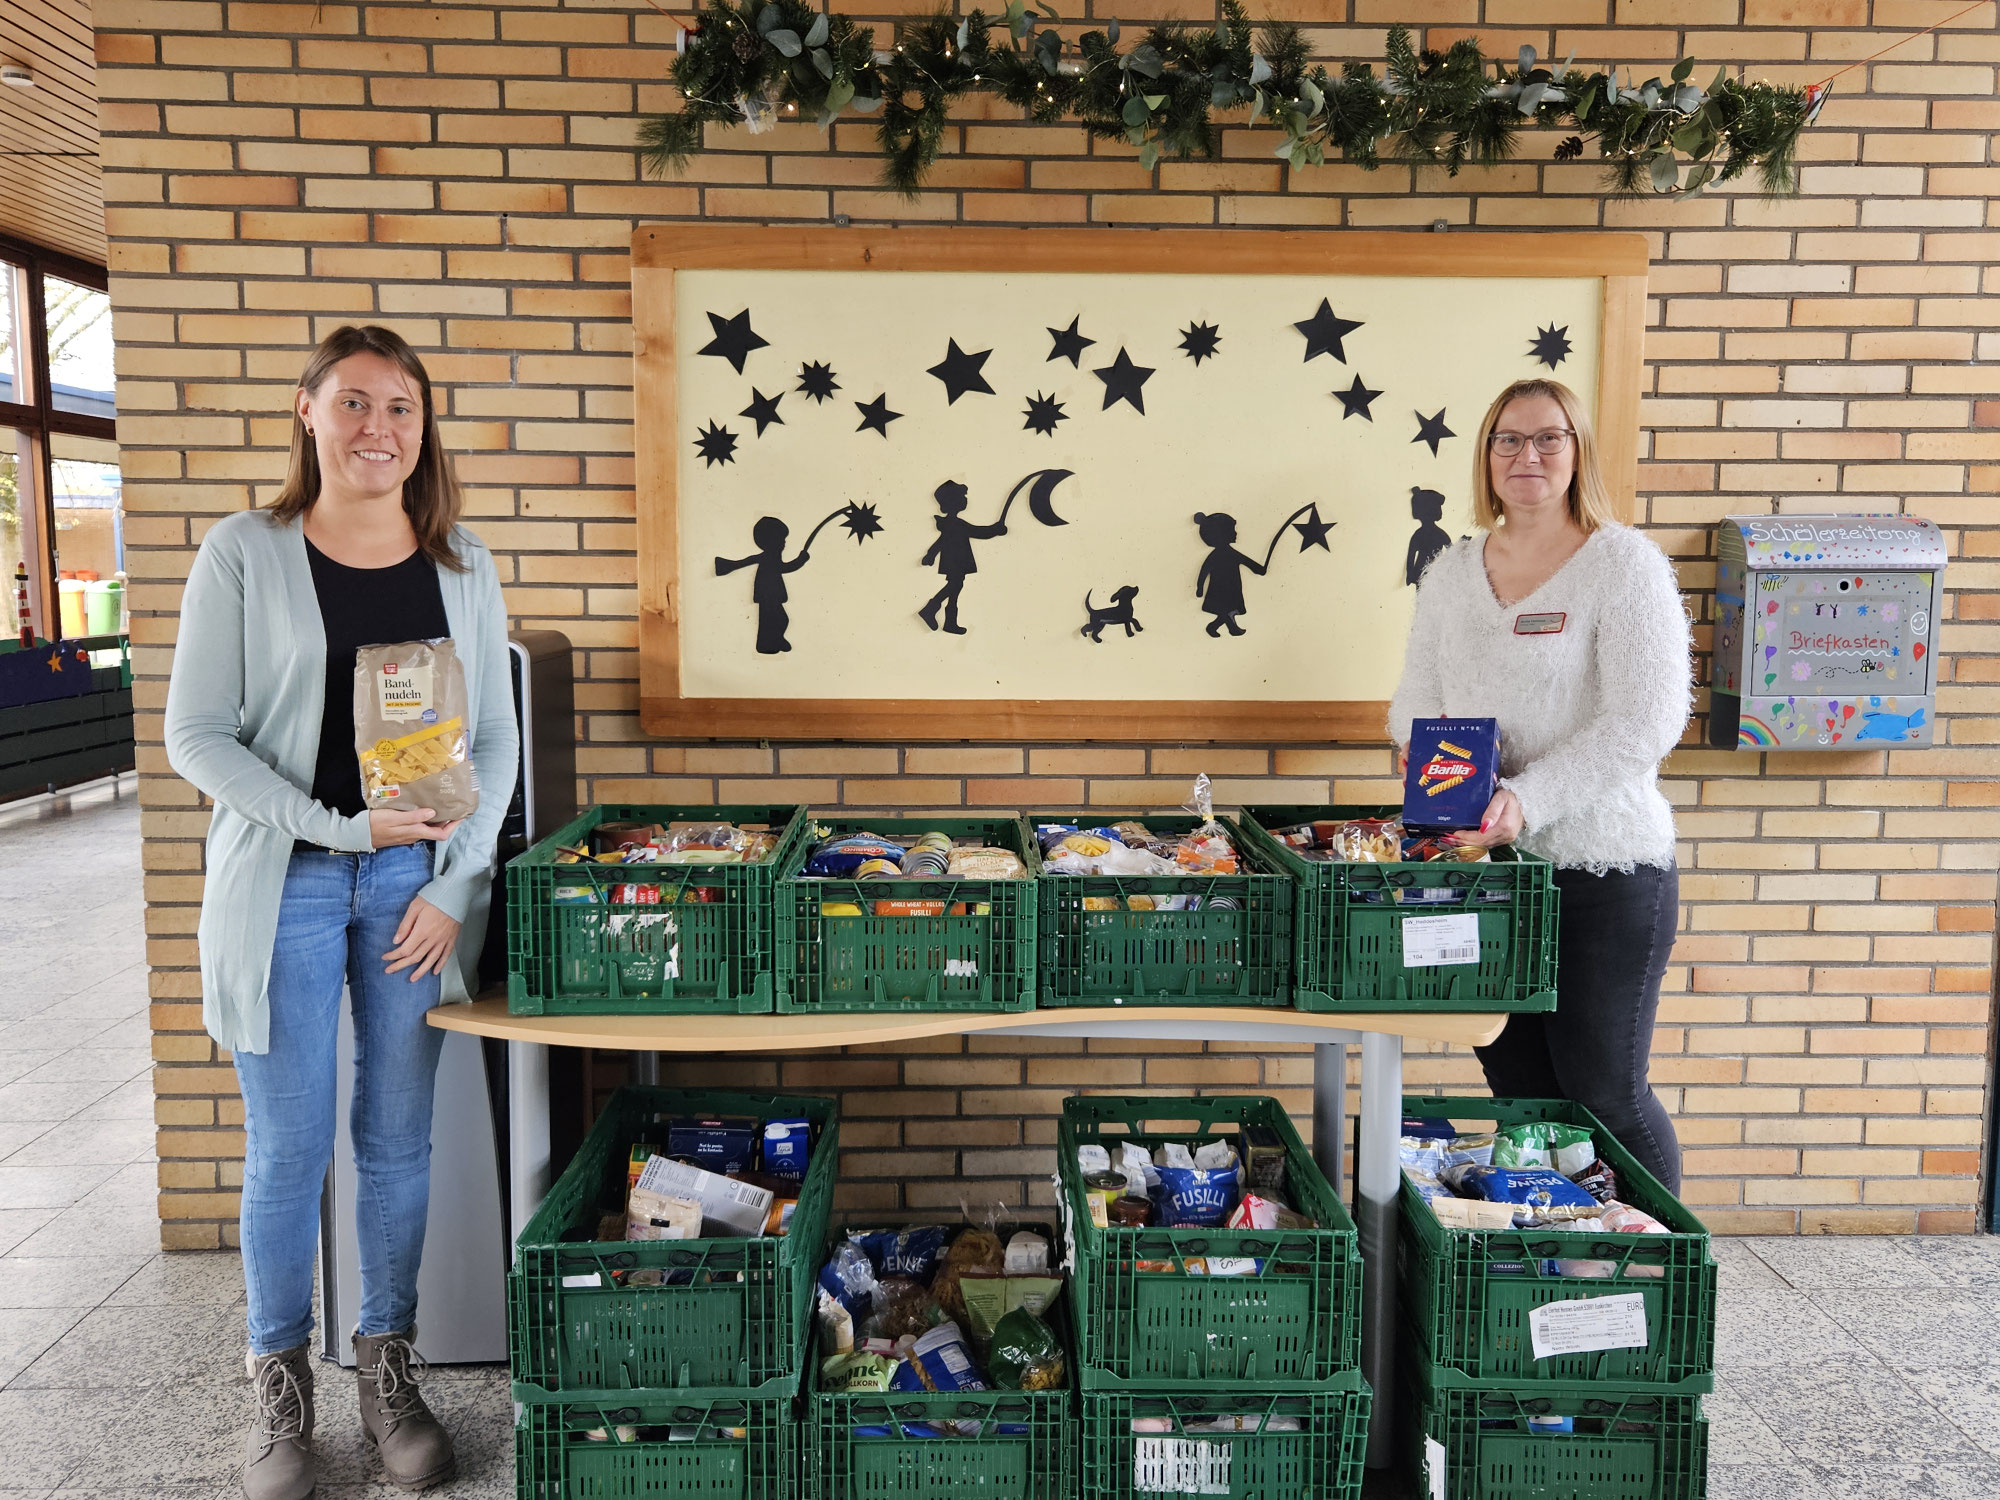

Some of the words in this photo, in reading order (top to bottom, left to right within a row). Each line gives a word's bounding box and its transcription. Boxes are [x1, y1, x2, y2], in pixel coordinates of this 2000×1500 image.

[1788, 631, 1890, 654] Briefkasten
[385, 690, 422, 700] nudeln
[1427, 764, 1471, 775] Barilla
[910, 909, 932, 917] FUSILLI
[1507, 1176, 1565, 1188] PENNE
[1172, 1188, 1225, 1211] FUSILLI
